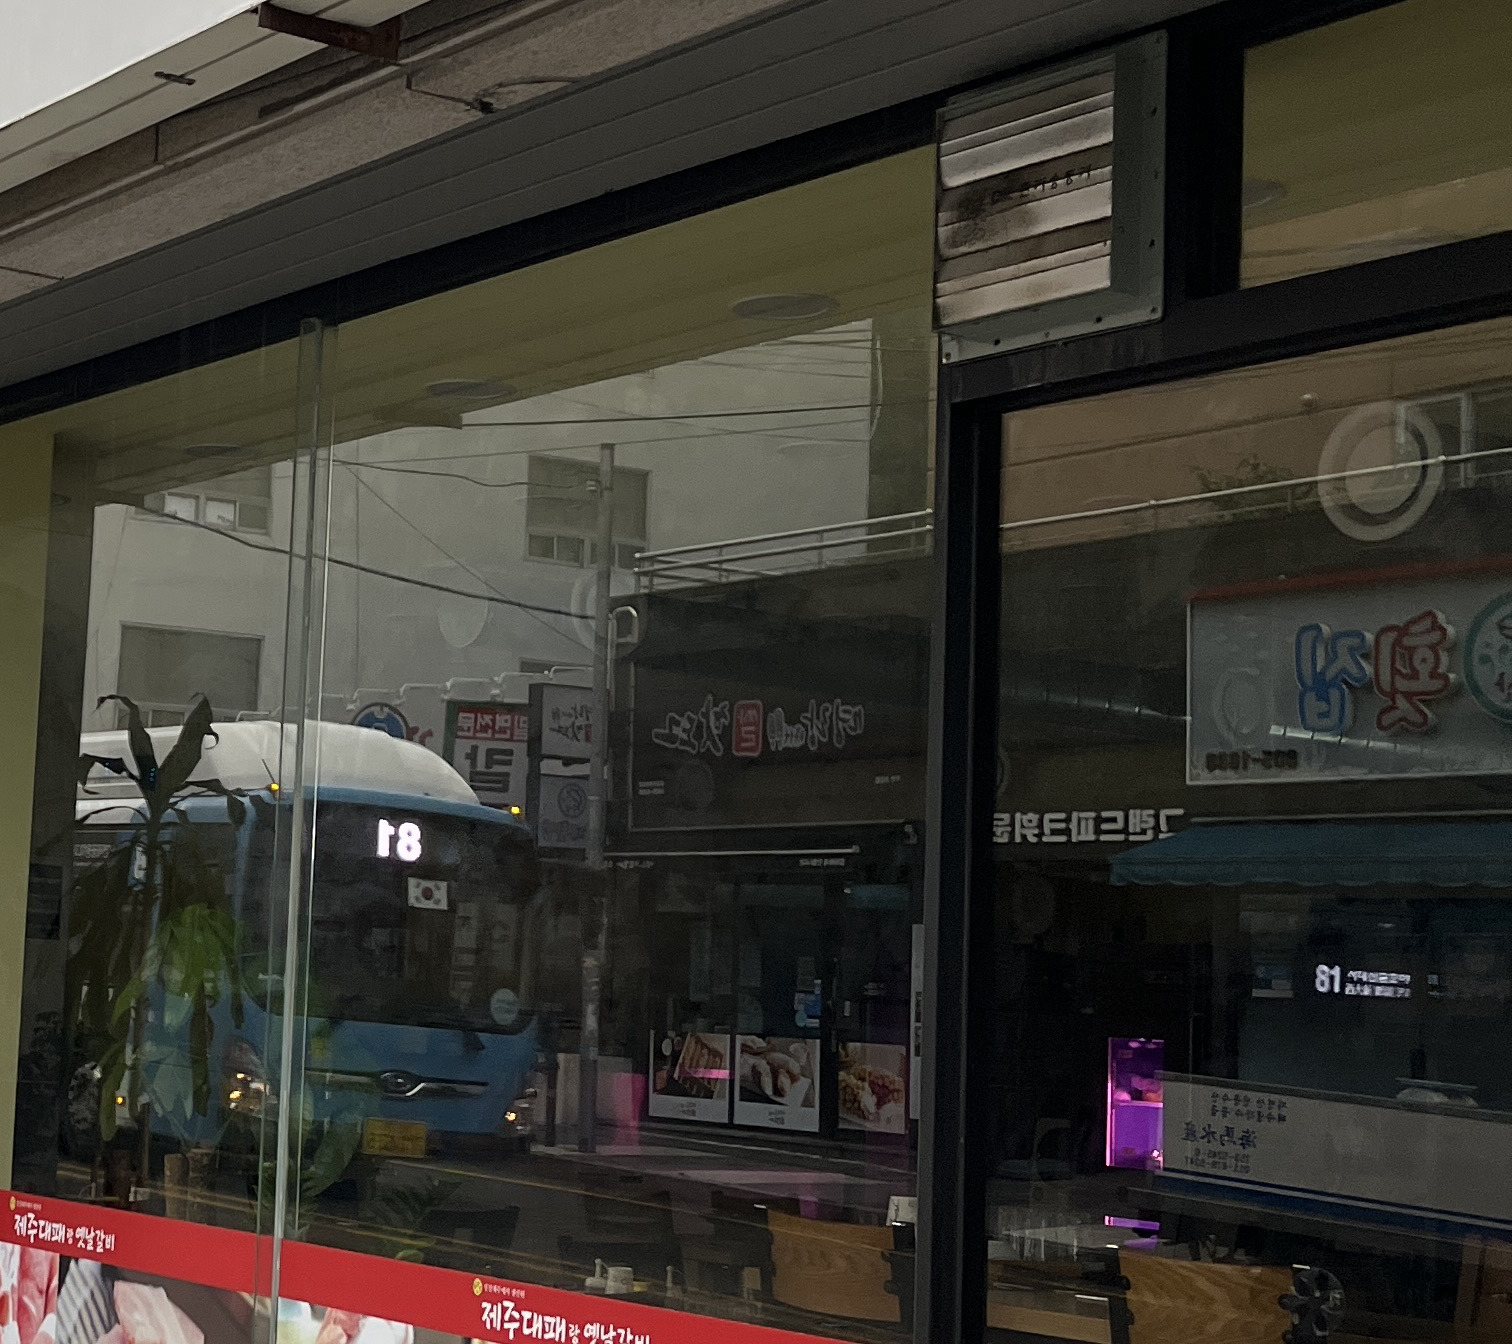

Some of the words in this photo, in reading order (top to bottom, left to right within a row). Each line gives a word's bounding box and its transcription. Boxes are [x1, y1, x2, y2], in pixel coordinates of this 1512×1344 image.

[14, 1212, 75, 1245] 제주대패랑
[75, 1226, 116, 1253] 옛날갈비
[481, 1300, 580, 1344] 제주대패랑
